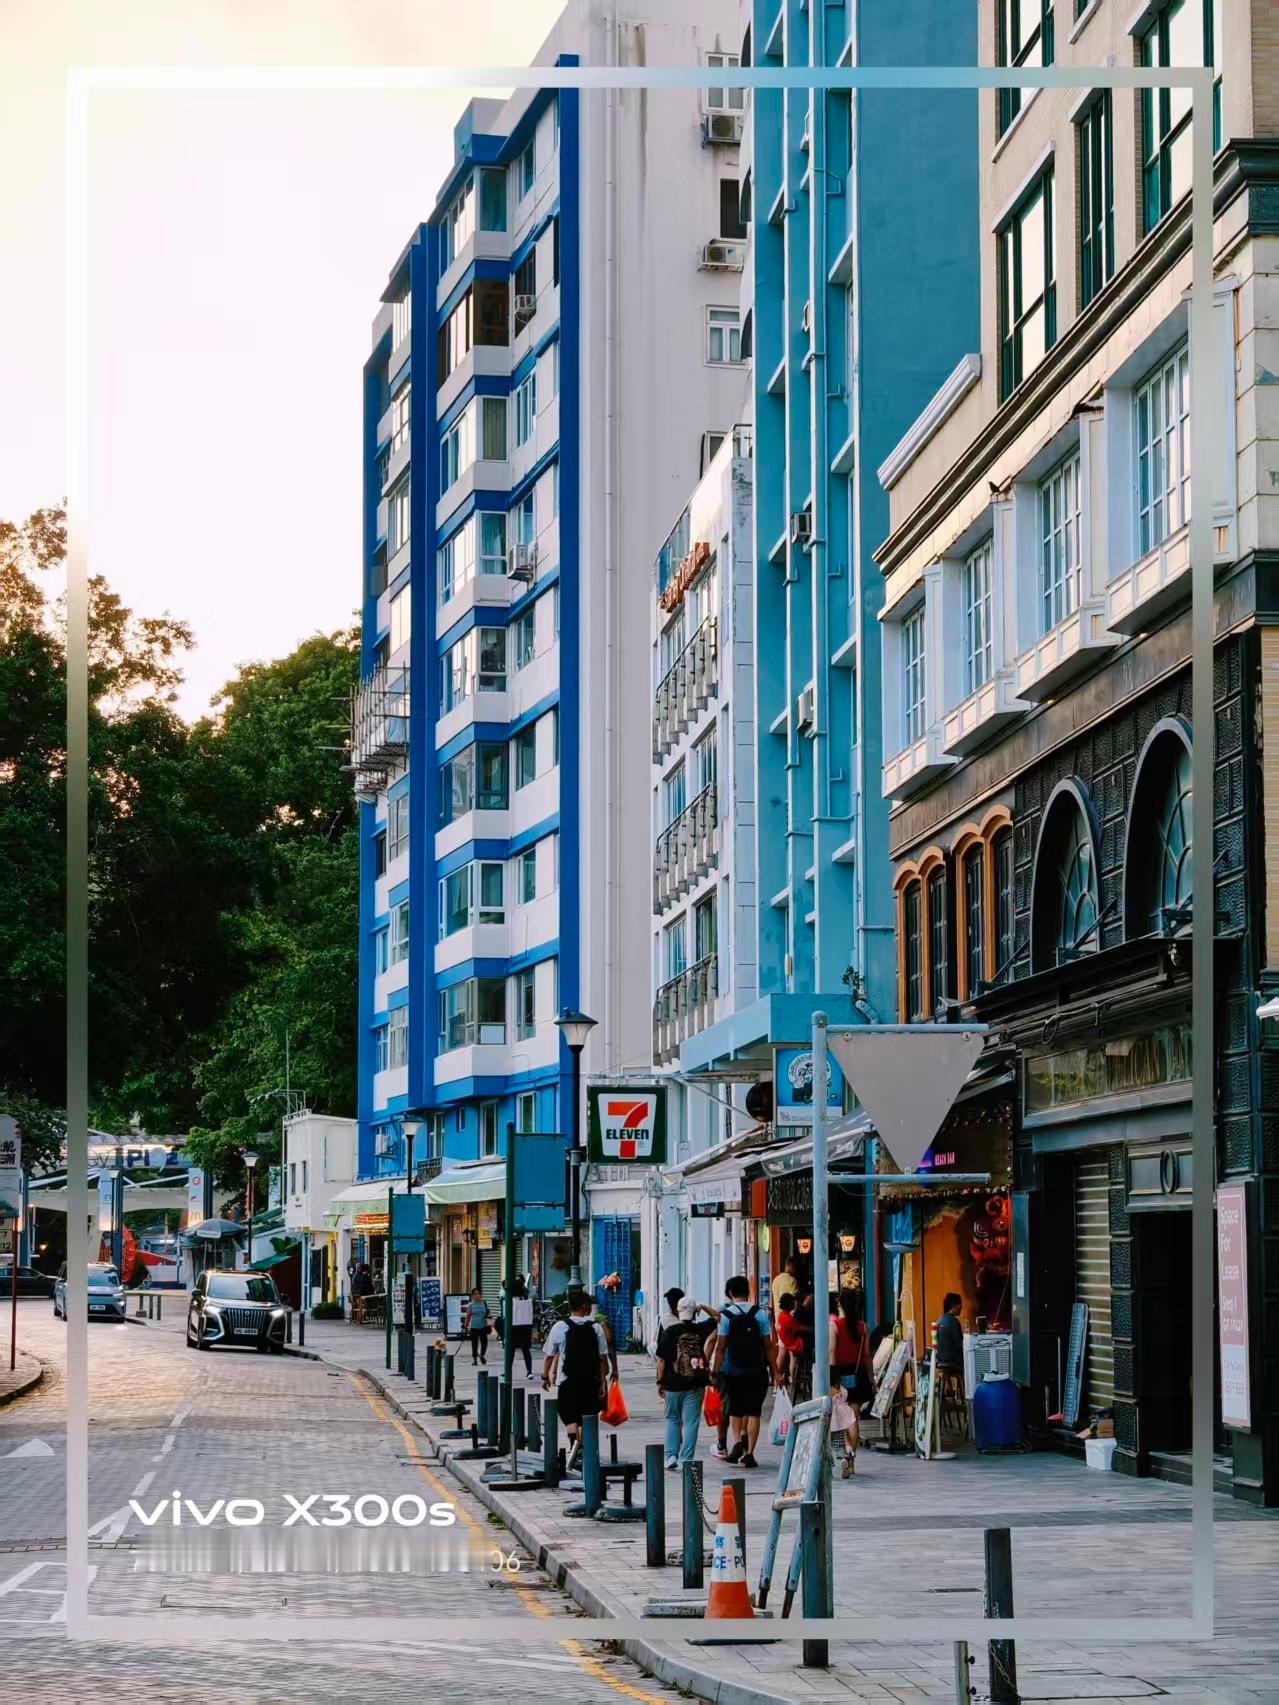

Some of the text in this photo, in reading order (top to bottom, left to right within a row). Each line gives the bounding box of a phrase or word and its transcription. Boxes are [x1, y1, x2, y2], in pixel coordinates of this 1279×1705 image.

[607, 1101, 649, 1158] 7
[1220, 1206, 1239, 1229] Space
[1220, 1232, 1232, 1253] For
[1221, 1259, 1239, 1281] Lease
